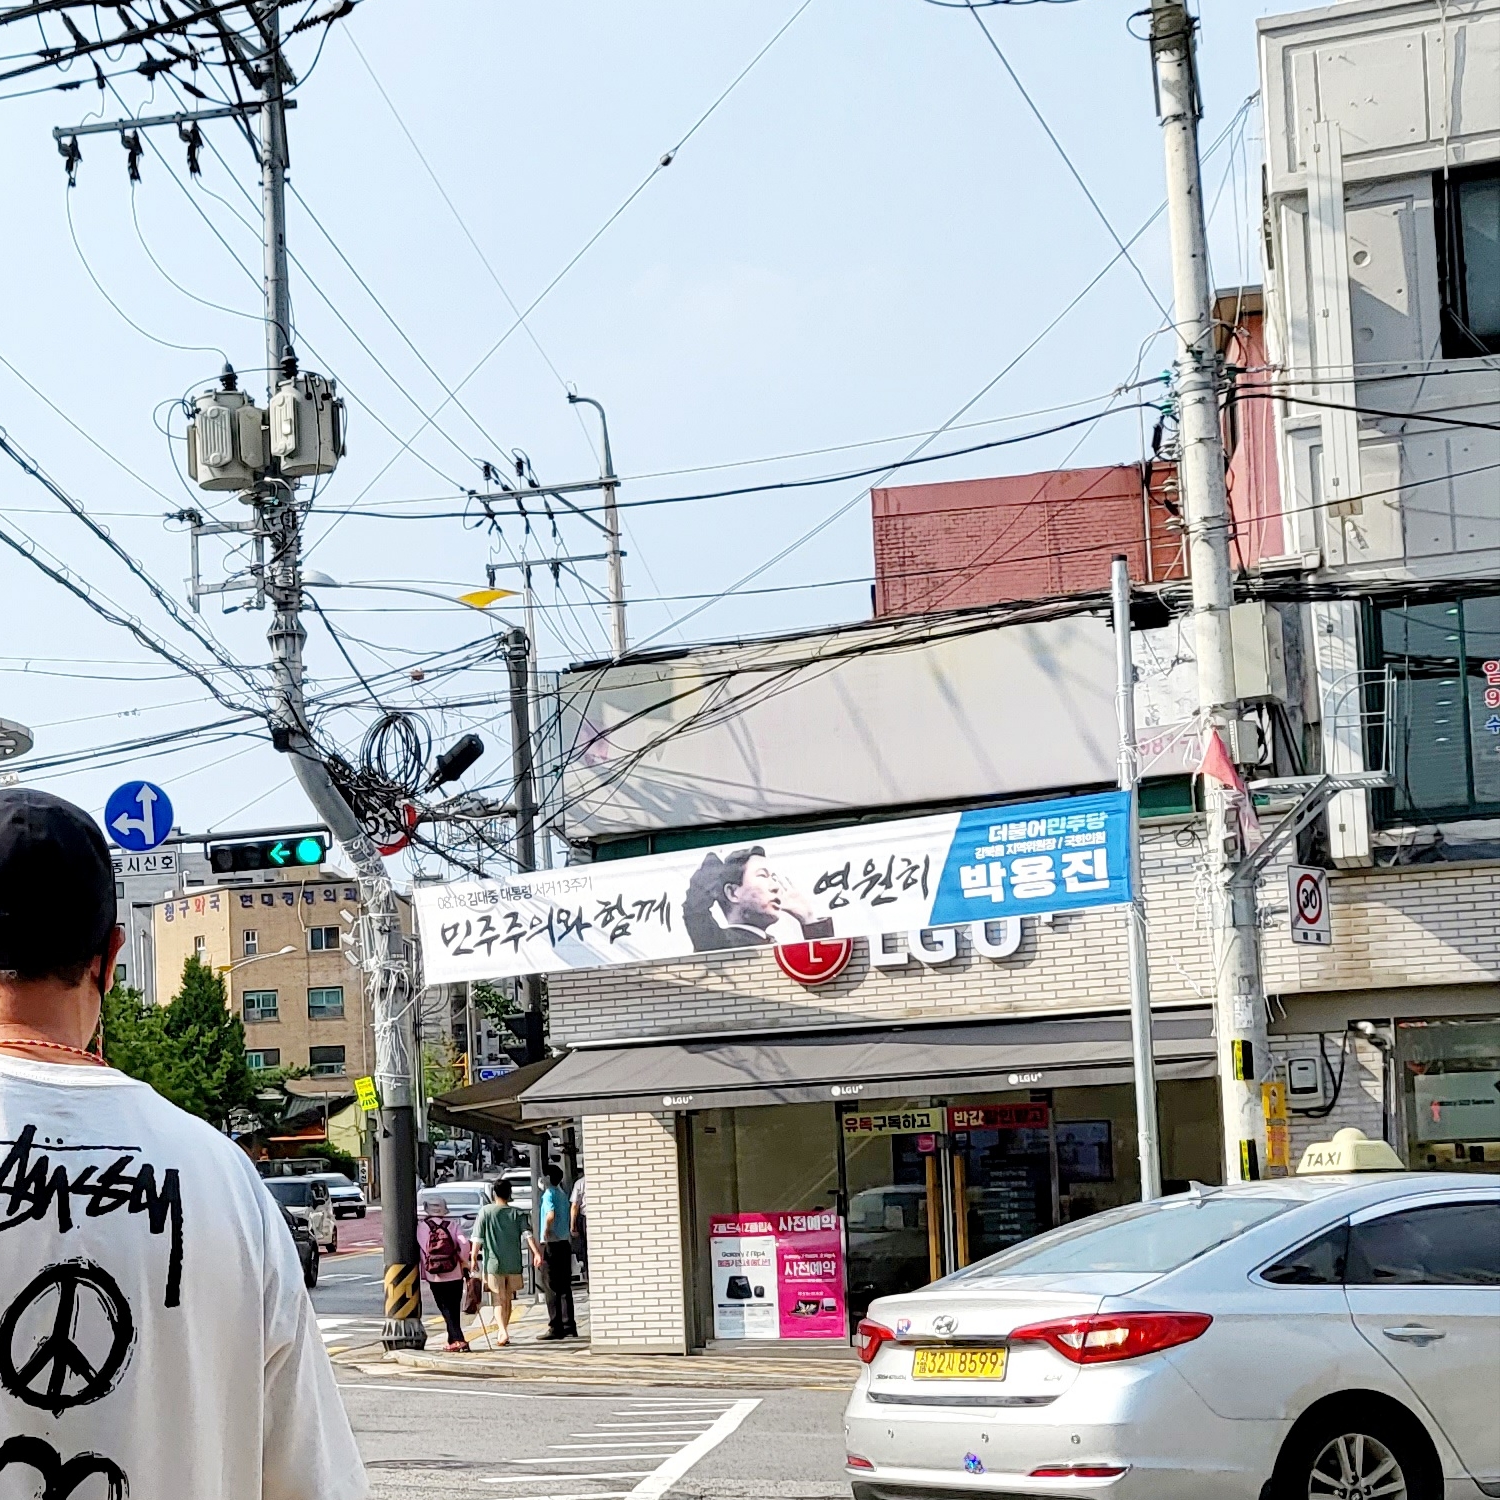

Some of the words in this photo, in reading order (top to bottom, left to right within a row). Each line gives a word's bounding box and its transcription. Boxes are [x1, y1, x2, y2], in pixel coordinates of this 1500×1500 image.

[988, 811, 1109, 843] 더불어민주당
[1063, 830, 1107, 847] 국회의원
[813, 854, 929, 910] 영원히
[959, 847, 1111, 902] 박용진
[466, 889, 499, 907] 김대중
[500, 885, 533, 902] 대통령
[534, 880, 556, 898] 서거
[555, 875, 594, 894] 13주기
[1300, 888, 1319, 909] 30
[440, 906, 593, 957] 민주주의와
[593, 891, 672, 944] 함께
[844, 1113, 931, 1133] 유독구독하고
[1306, 1152, 1342, 1167] TAXI
[779, 1214, 837, 1233] 사전예약
[784, 1261, 837, 1277] 사전예약
[958, 1352, 1000, 1373] 8599
